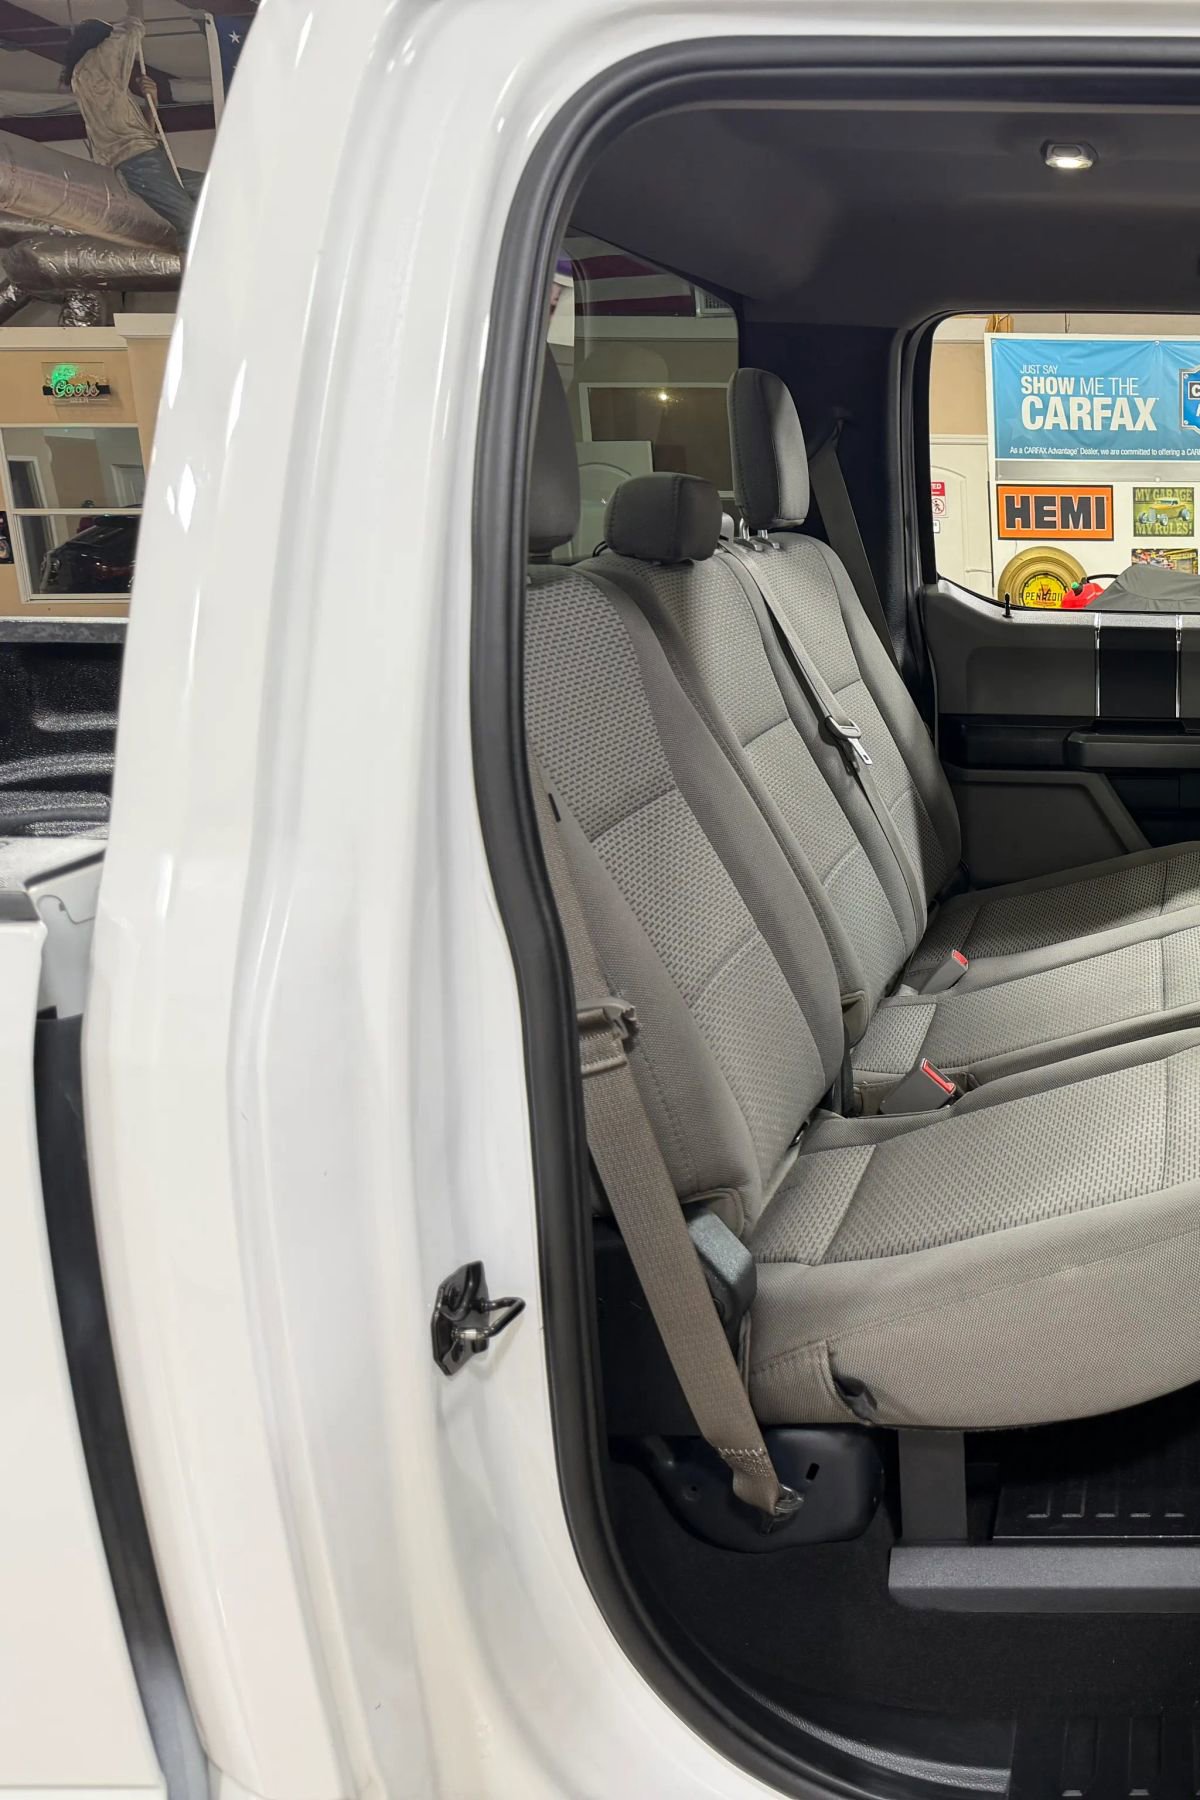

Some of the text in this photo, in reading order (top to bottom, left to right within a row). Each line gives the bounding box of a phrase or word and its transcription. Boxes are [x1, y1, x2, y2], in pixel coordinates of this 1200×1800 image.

[1020, 364, 1059, 375] JUST SAY
[53, 379, 100, 398] Coors
[1020, 376, 1140, 396] SHOW ME THE
[1021, 395, 1158, 431] CARFAX
[1009, 446, 1018, 454] As
[1024, 446, 1047, 455] CARFAX
[1080, 447, 1100, 456] Dealer,
[1120, 448, 1151, 456] committed
[1151, 448, 1157, 456] to
[1158, 448, 1180, 457] offering
[1135, 488, 1193, 501] MY GARAGE
[1004, 494, 1107, 531] HEMI
[1135, 523, 1193, 536] MY RULES!
